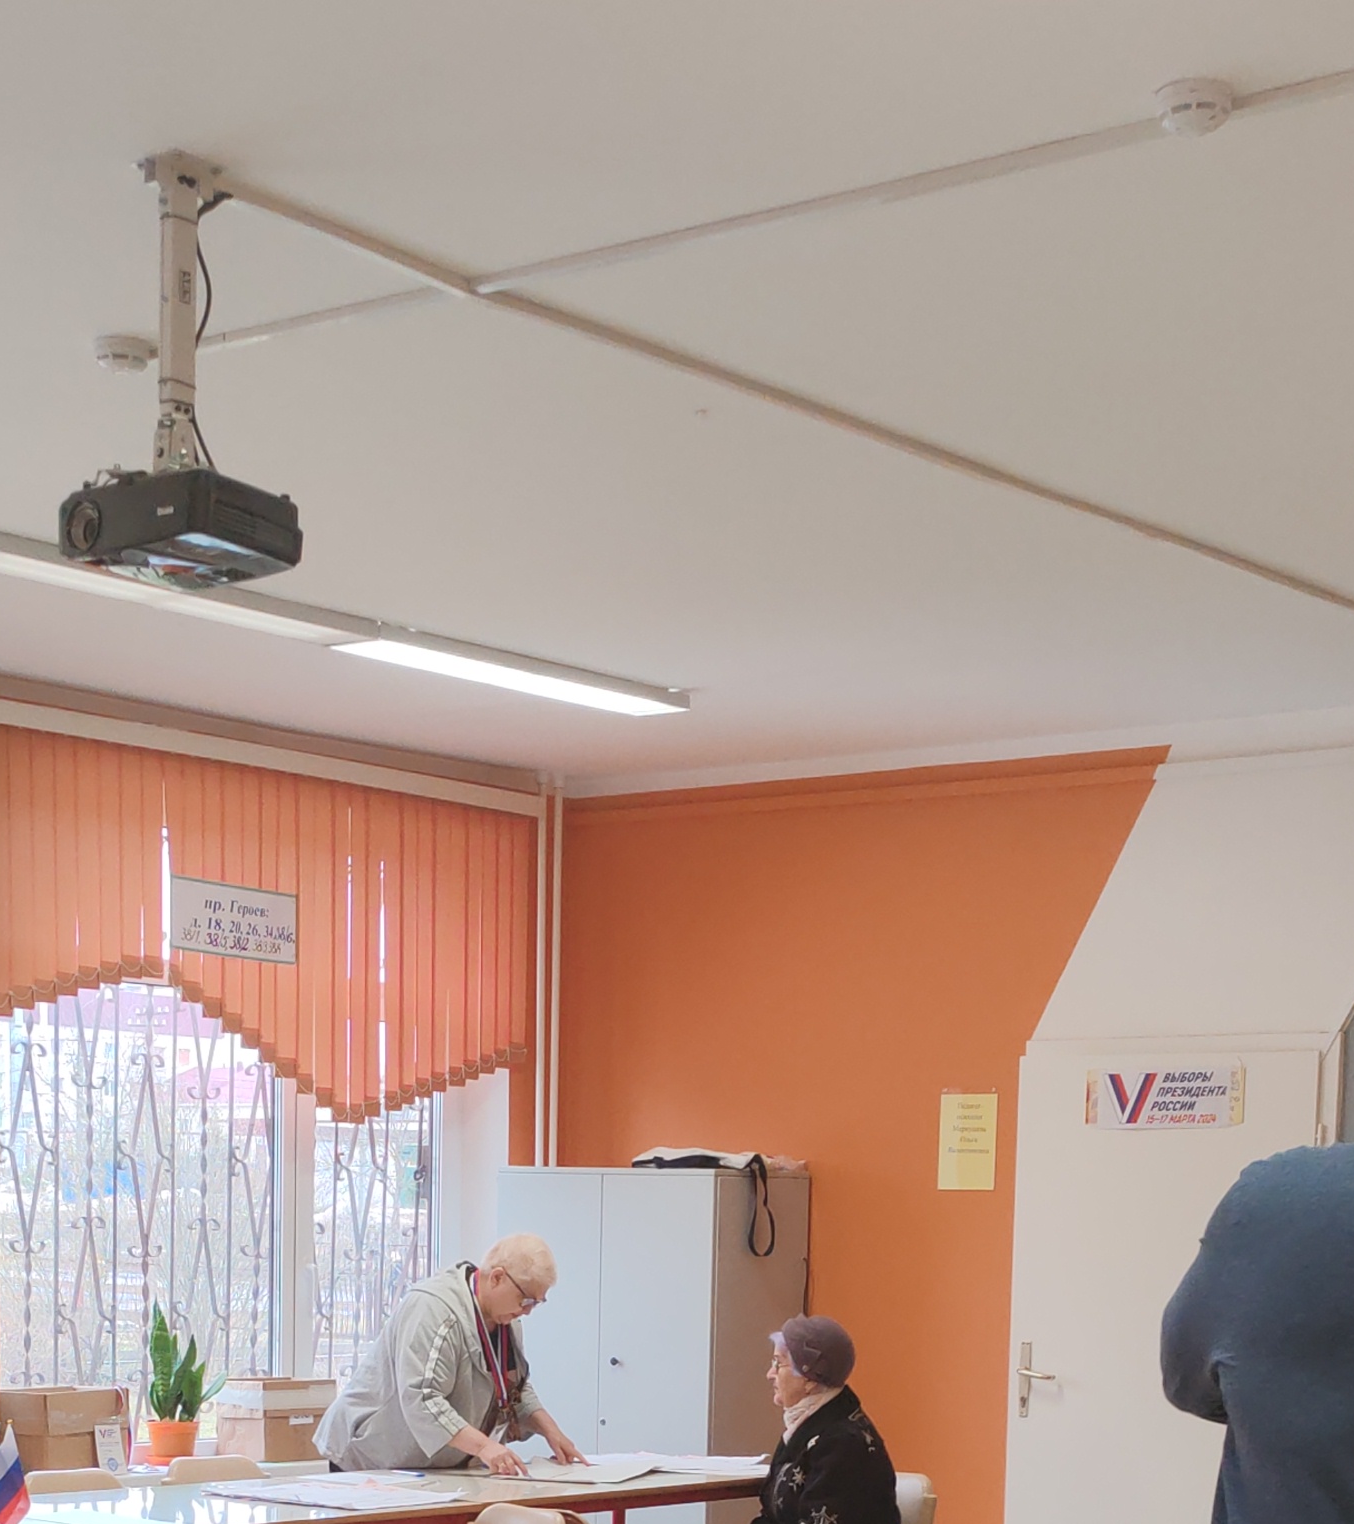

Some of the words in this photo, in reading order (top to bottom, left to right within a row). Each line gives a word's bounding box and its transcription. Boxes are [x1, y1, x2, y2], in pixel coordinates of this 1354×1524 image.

[204, 899, 225, 914] пр.
[230, 900, 270, 918] Героев:
[1162, 1070, 1215, 1084] ВЫБОРЫ
[1156, 1085, 1228, 1098] ПРЕЗИДЕНТА
[1150, 1100, 1197, 1112] РОССИИ
[1169, 1113, 1196, 1124] МАРТА
